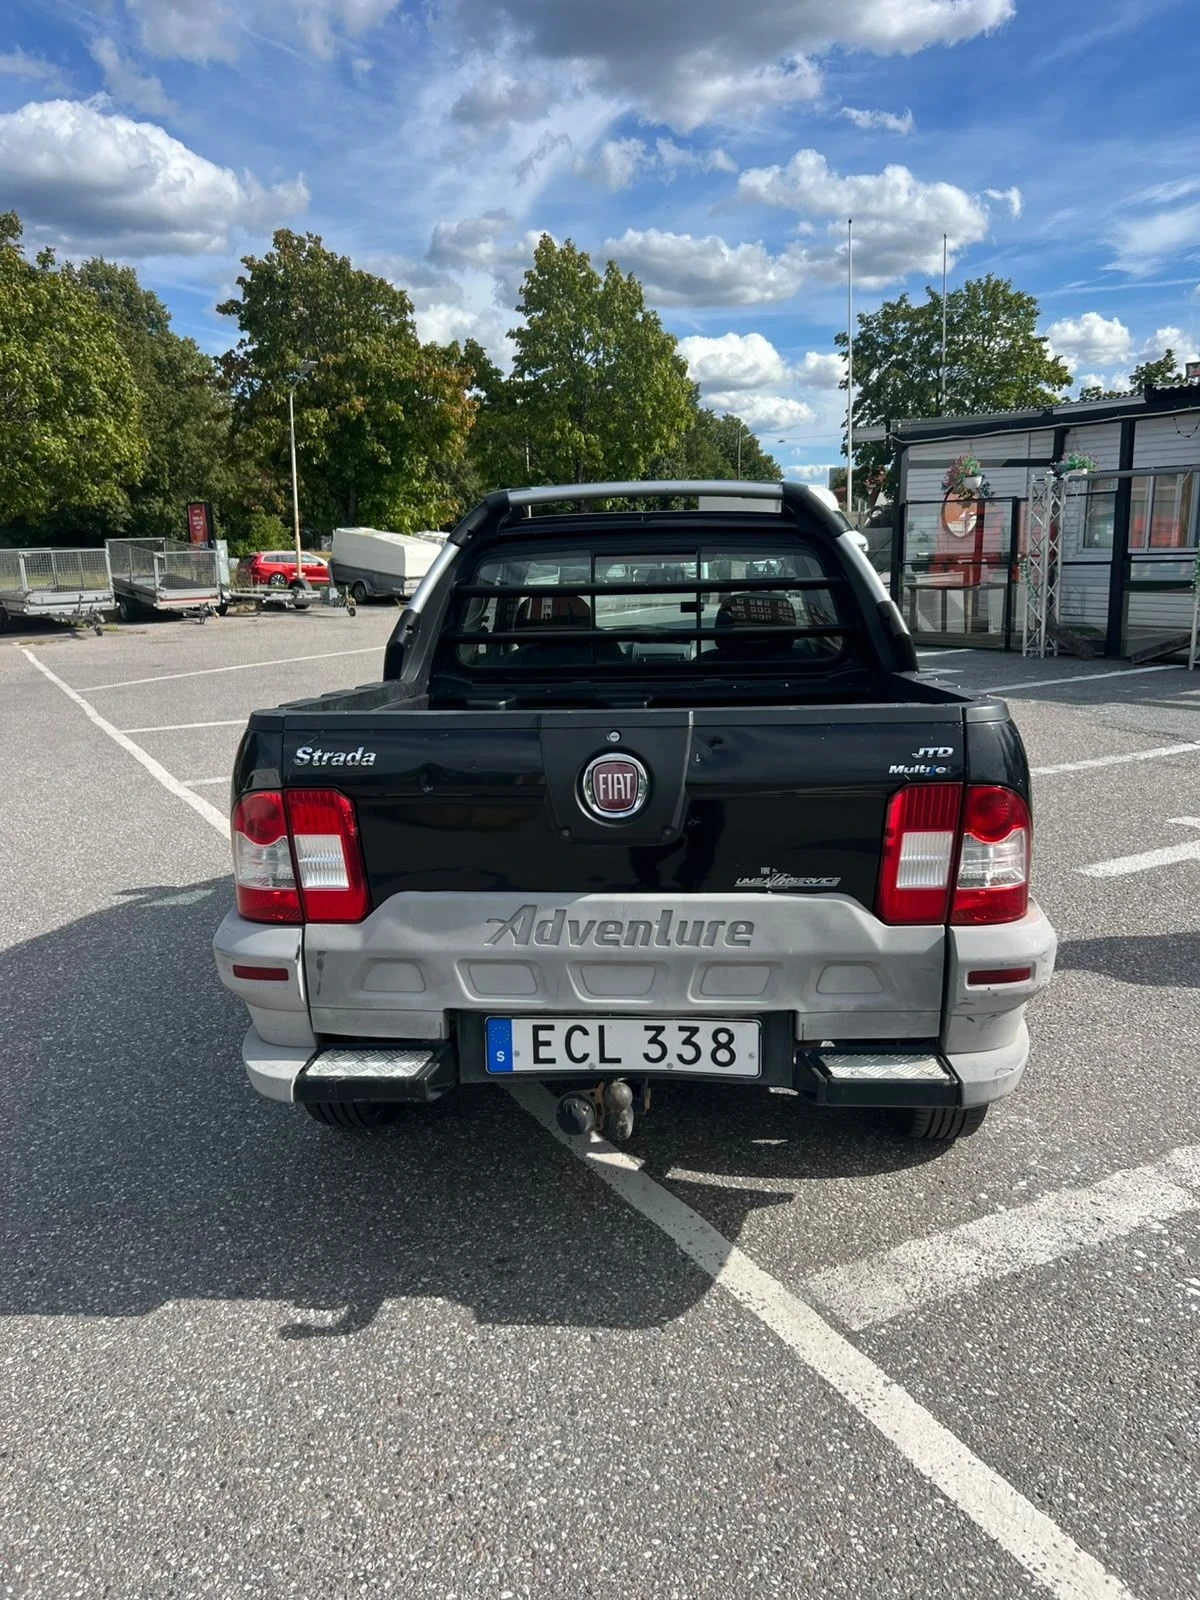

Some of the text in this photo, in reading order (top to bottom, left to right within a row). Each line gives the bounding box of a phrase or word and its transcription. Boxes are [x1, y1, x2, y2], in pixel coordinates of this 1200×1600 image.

[293, 746, 377, 766] Strada
[911, 746, 954, 759] JTD
[599, 773, 634, 800] FIAT
[484, 904, 755, 948] Adventure
[496, 1051, 505, 1062] S
[531, 1024, 737, 1067] ECL 338
